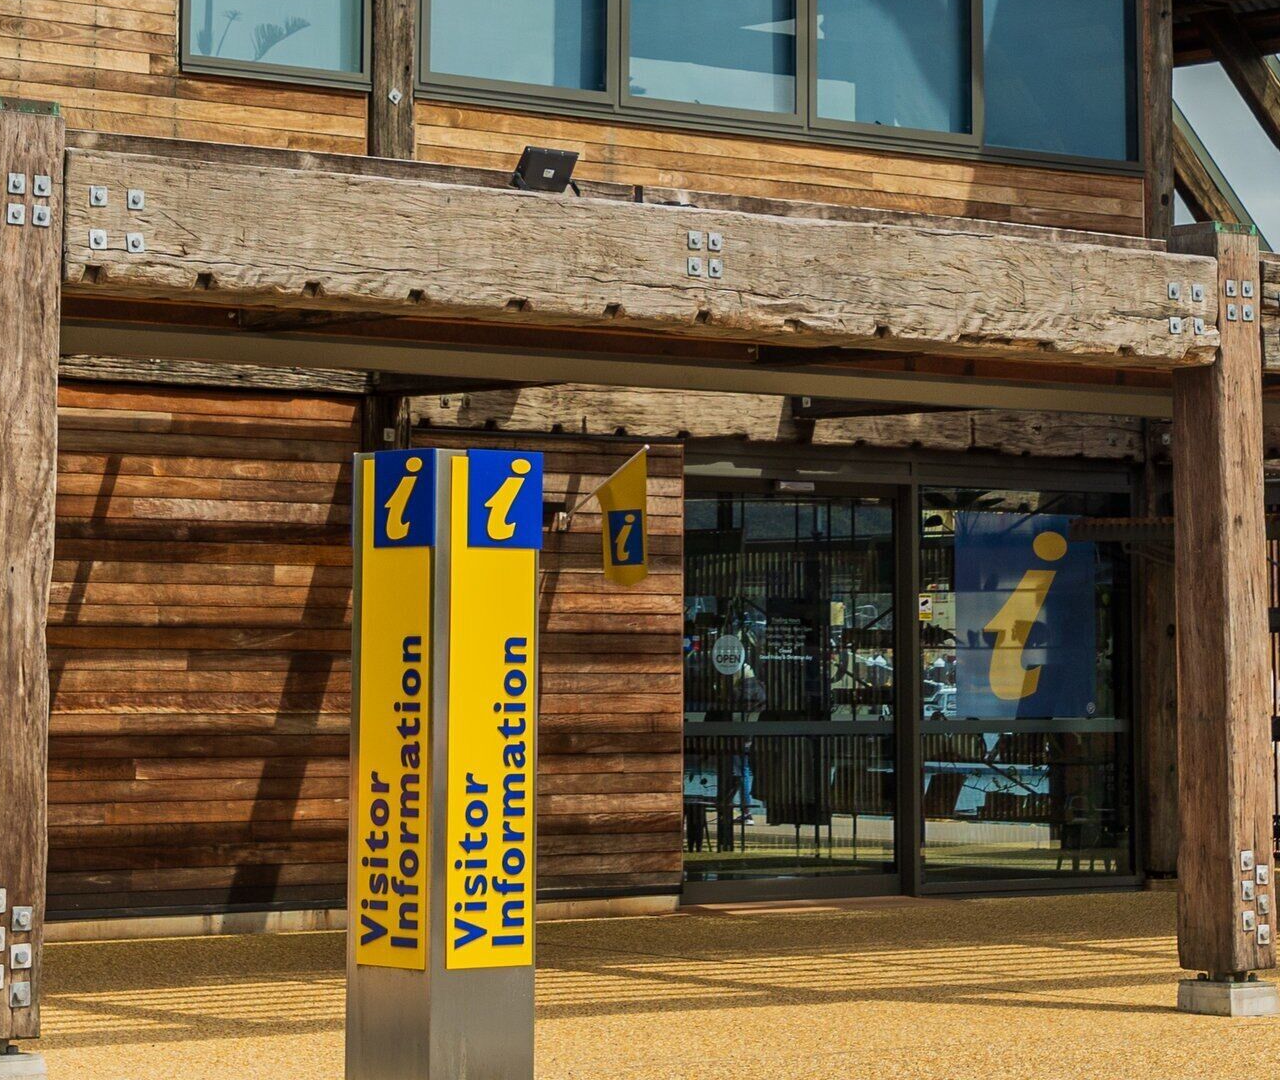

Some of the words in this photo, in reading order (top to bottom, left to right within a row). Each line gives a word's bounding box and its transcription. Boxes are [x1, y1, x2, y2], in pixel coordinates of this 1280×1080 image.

[484, 458, 532, 540] i
[716, 654, 741, 664] OPEN
[360, 771, 391, 947] Visitor
[391, 635, 423, 950] Information
[454, 772, 490, 950] Visitor
[492, 636, 528, 947] Information
